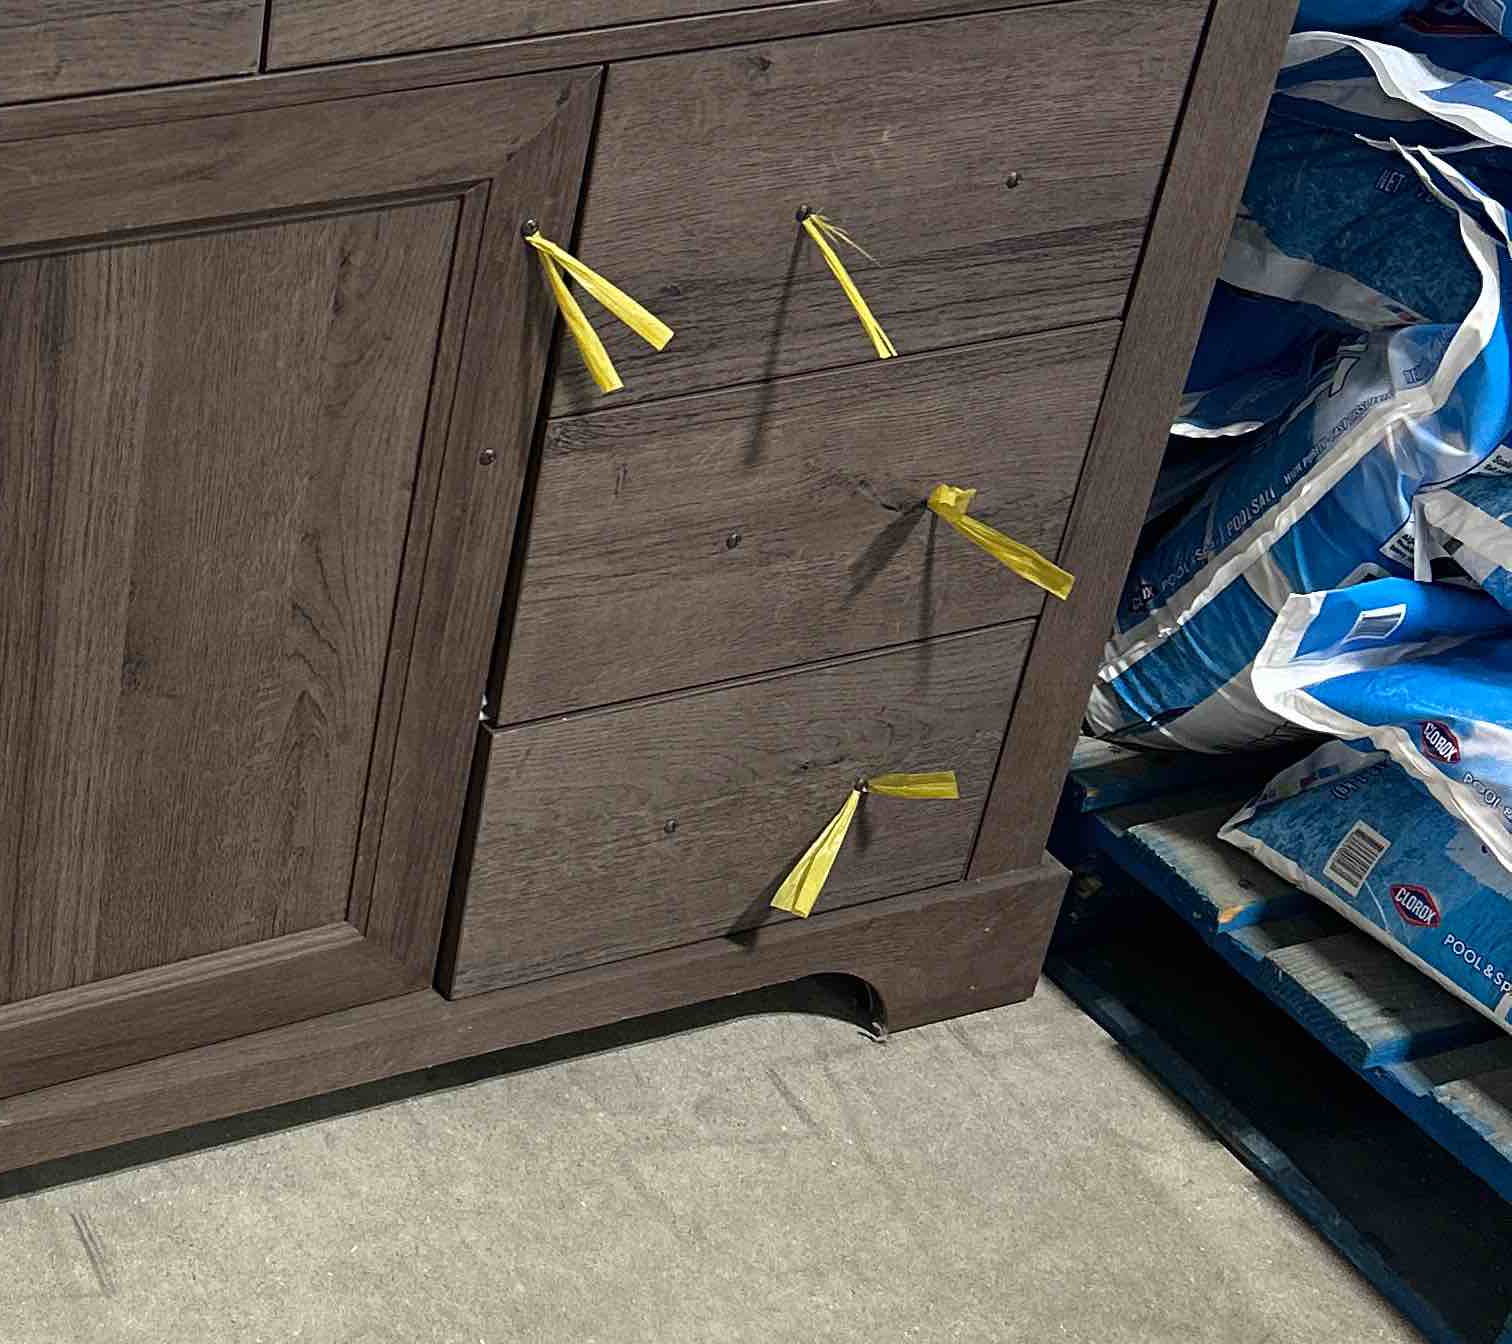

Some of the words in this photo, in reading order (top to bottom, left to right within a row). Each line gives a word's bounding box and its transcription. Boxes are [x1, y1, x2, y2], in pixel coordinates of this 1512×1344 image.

[1423, 722, 1458, 762] CLOROX
[1394, 887, 1436, 925] CLOROX
[1443, 933, 1481, 971] POOL
[1483, 964, 1494, 978] &
